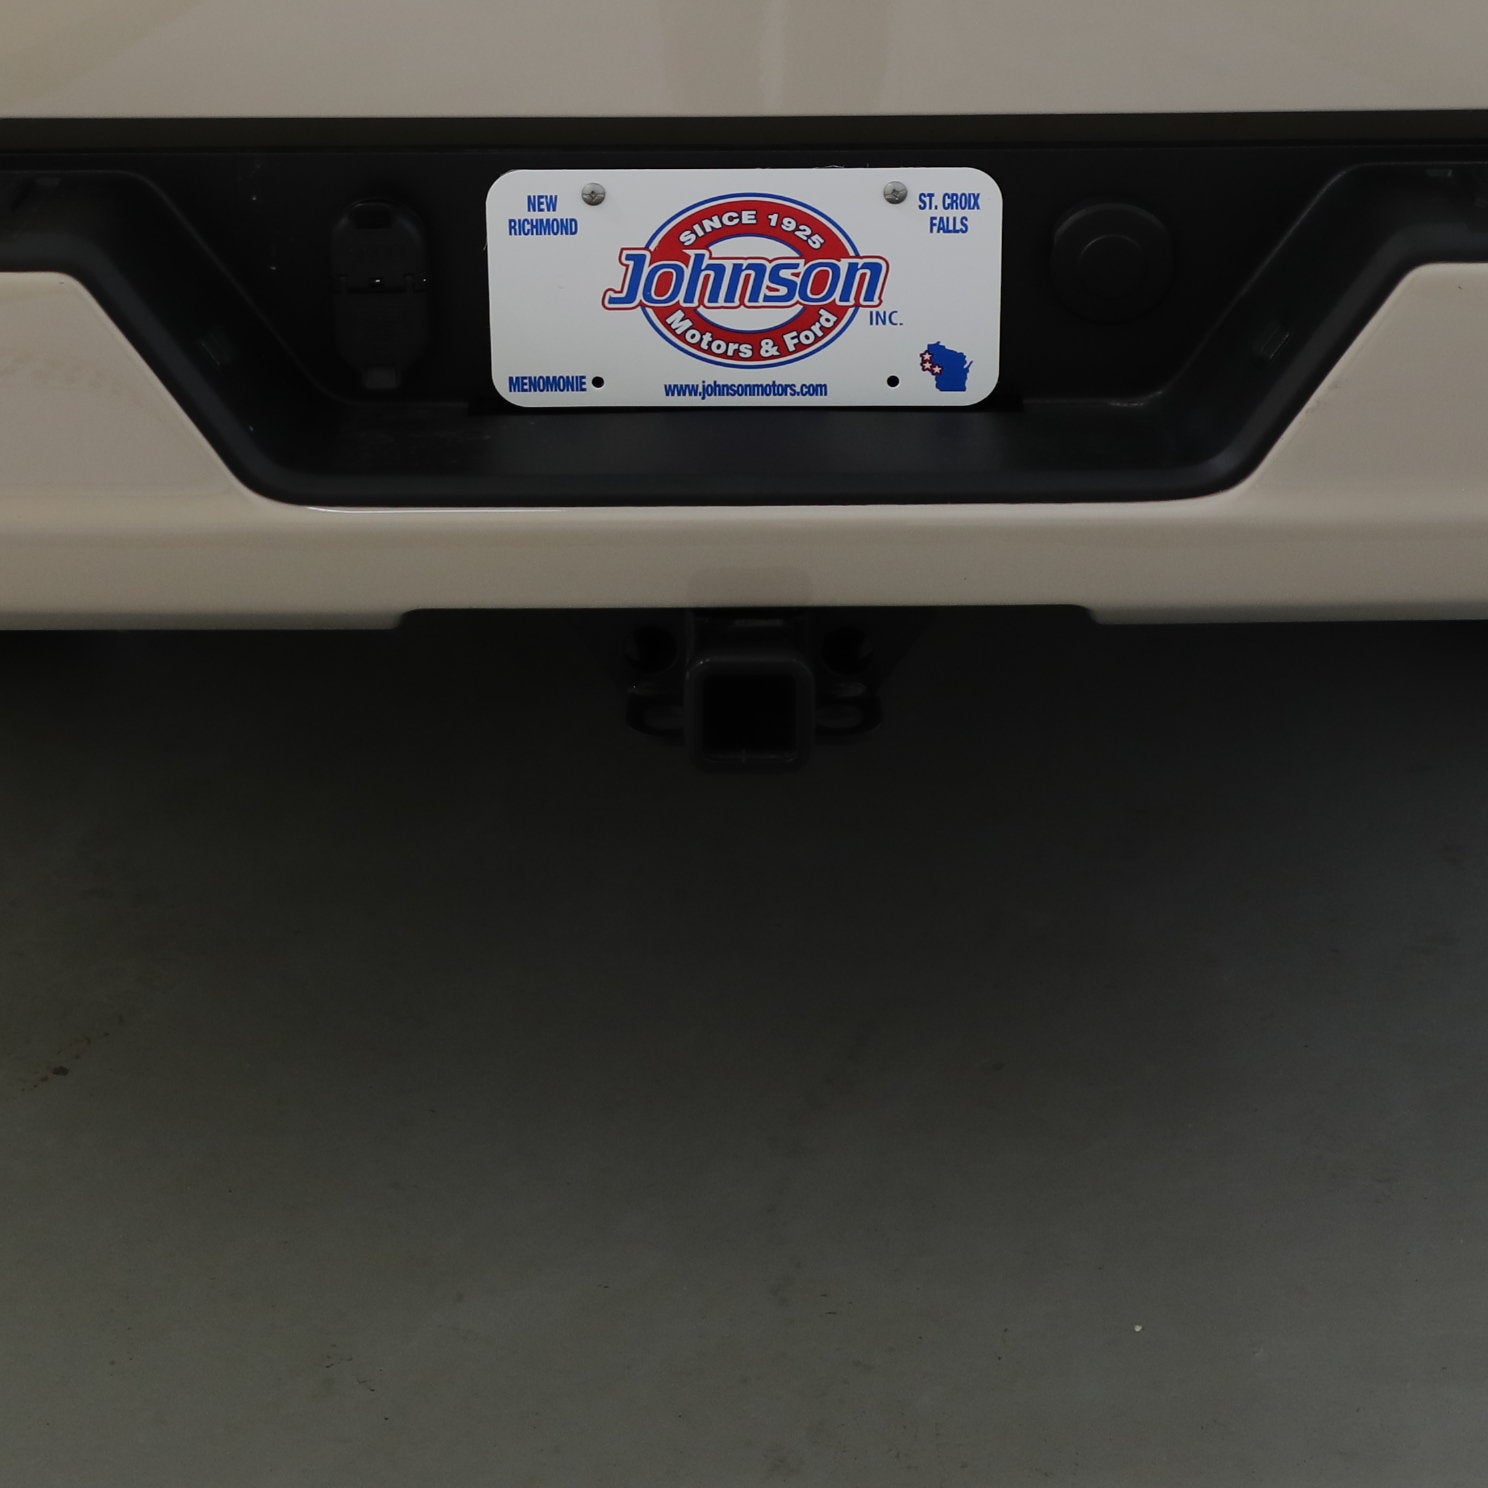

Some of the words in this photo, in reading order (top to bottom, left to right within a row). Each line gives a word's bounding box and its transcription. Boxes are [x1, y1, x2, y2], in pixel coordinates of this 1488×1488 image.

[526, 195, 558, 213] NEW
[918, 193, 938, 211] ST.
[941, 193, 981, 211] CROIX
[508, 218, 578, 236] RICHMOND
[678, 209, 758, 247] SINCE
[767, 212, 826, 251] 1925
[929, 216, 969, 234] FALLS
[605, 250, 886, 308] Johnson
[868, 310, 904, 326] INC.
[664, 309, 754, 359] Motors
[759, 338, 781, 358] &
[782, 308, 839, 353] Ford
[508, 375, 587, 393] MENOMONIE
[664, 381, 828, 399] www.johnsonmotors.com
